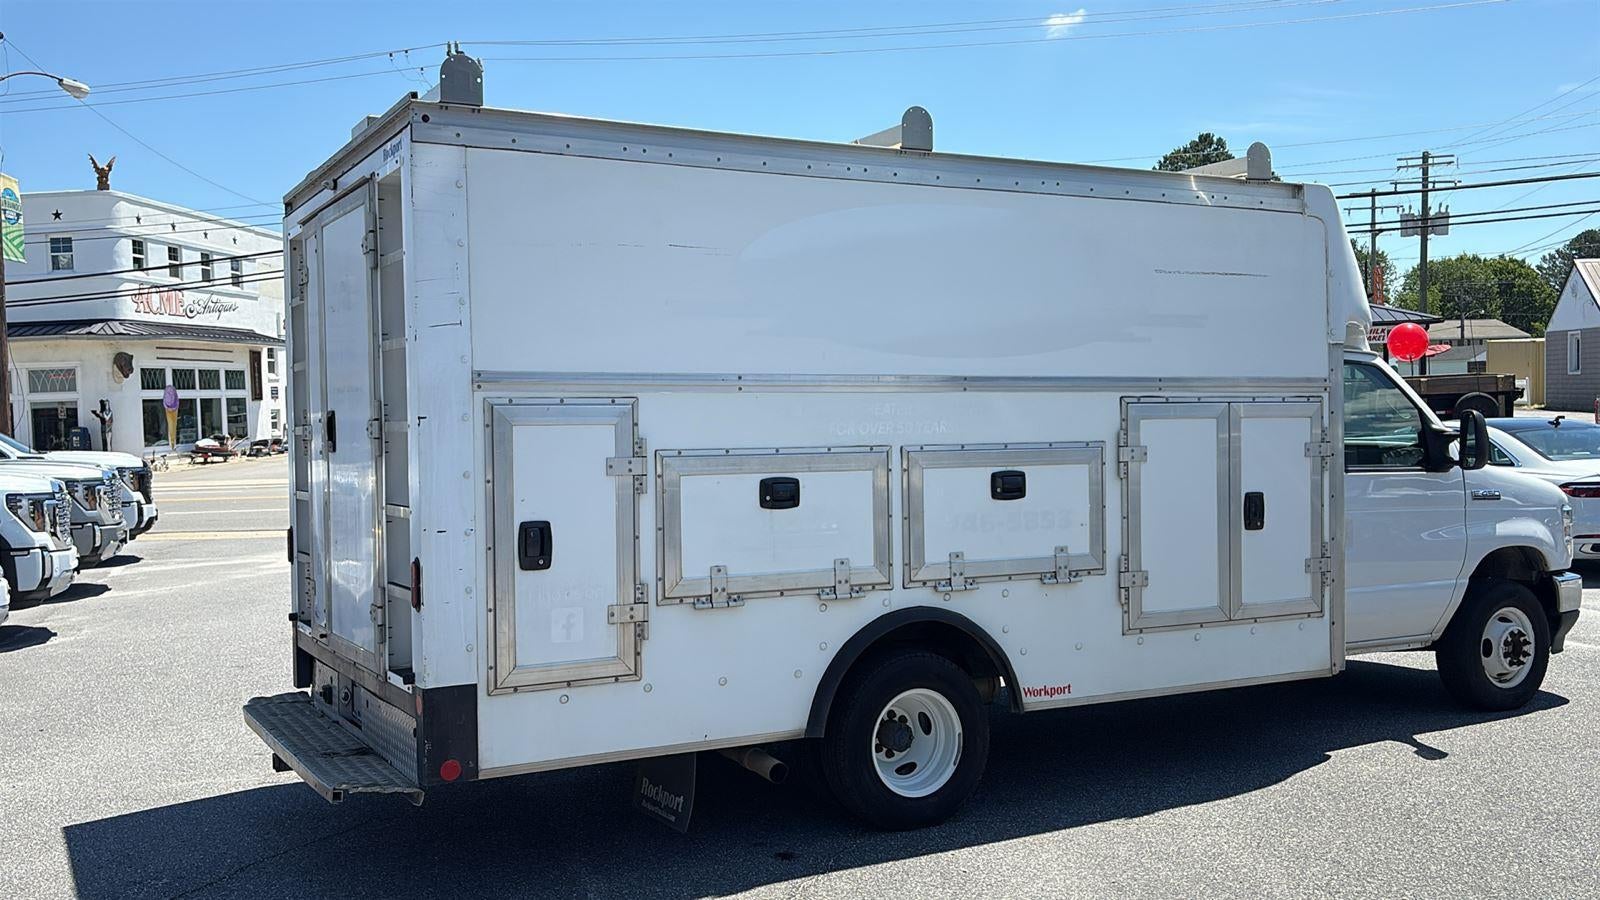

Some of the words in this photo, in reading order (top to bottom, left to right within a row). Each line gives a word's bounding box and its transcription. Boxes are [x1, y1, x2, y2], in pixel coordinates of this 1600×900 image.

[131, 283, 185, 317] ACME
[1022, 683, 1073, 699] Workport
[641, 776, 684, 813] Rockport
